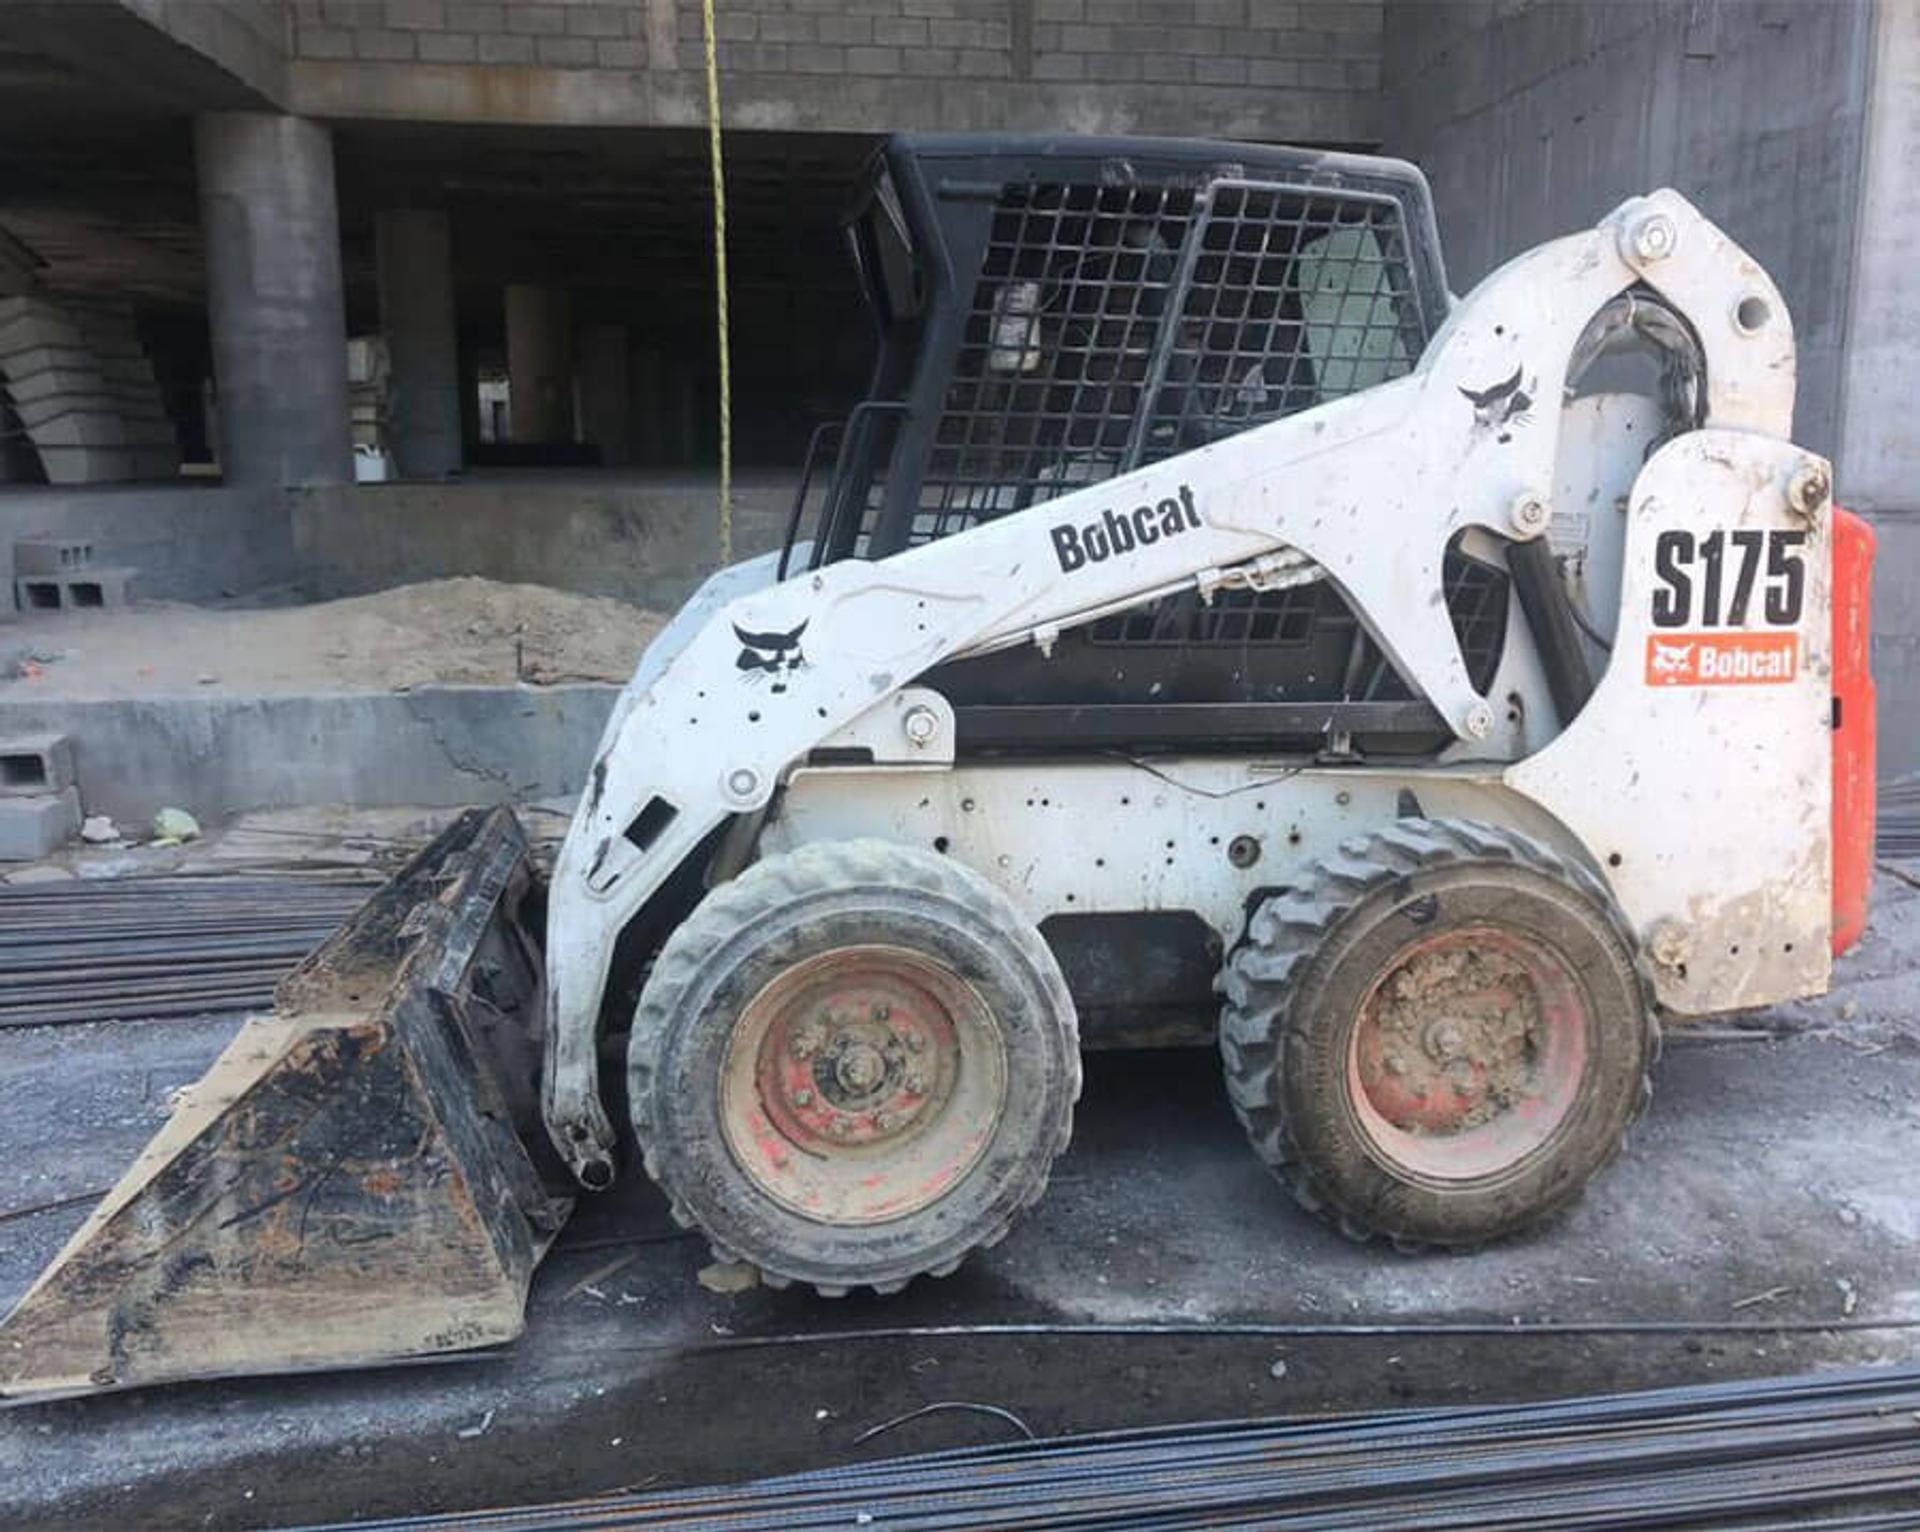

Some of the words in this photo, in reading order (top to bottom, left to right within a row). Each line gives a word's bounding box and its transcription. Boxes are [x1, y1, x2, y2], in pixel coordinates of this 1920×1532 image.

[1050, 484, 1202, 574] Bobcat
[1652, 530, 1806, 628] S175
[1699, 646, 1793, 678] Bobcat
